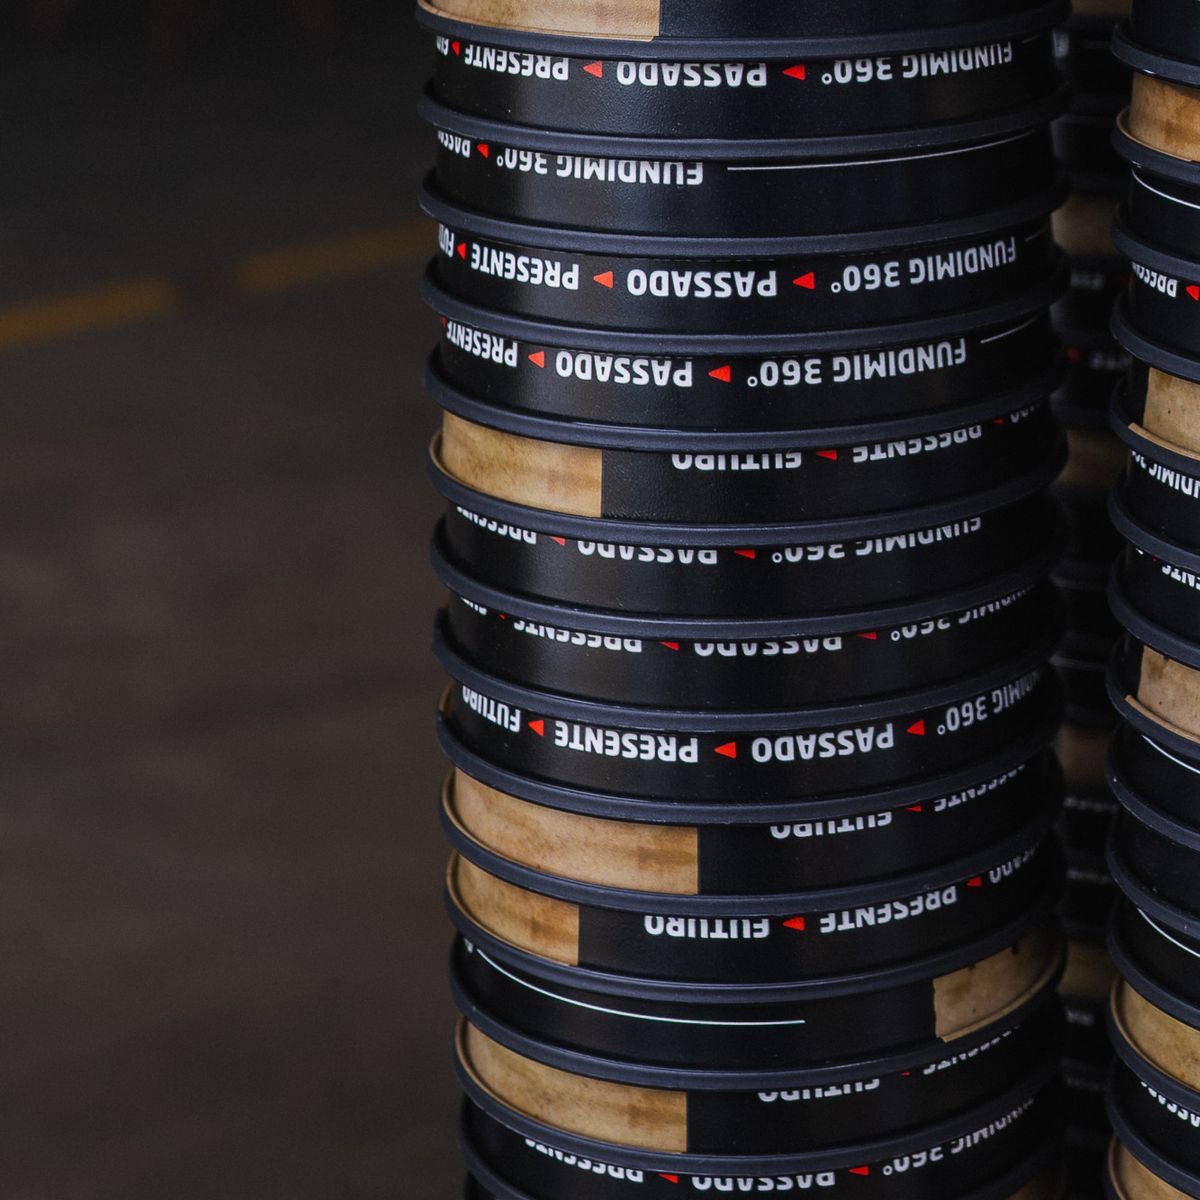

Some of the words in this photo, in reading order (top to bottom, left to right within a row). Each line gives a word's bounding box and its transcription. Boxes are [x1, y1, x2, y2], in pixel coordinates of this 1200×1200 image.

[465, 45, 569, 80] PRESENTE
[616, 62, 766, 87] PASSADO
[822, 59, 892, 84] 360°
[902, 44, 1012, 78] FUNDIMIG
[497, 149, 547, 174] 360°
[557, 156, 703, 185] FUNDIMIG
[472, 244, 579, 290] PRESENTE
[831, 262, 900, 293] 360°
[909, 238, 1015, 284] FUNDIMIG
[627, 269, 776, 298] PASSADO
[447, 321, 517, 367] PRESENTE
[833, 339, 966, 382] FUNDIMIG
[556, 351, 692, 387] PASSADO
[747, 359, 822, 387] 360°
[463, 686, 520, 732] FUTURO
[937, 696, 987, 735] 360°
[555, 721, 698, 762] PRESENTE
[752, 723, 894, 762] PASSADO
[645, 916, 769, 938] FUTURO
[820, 886, 956, 933] PRESENTE
